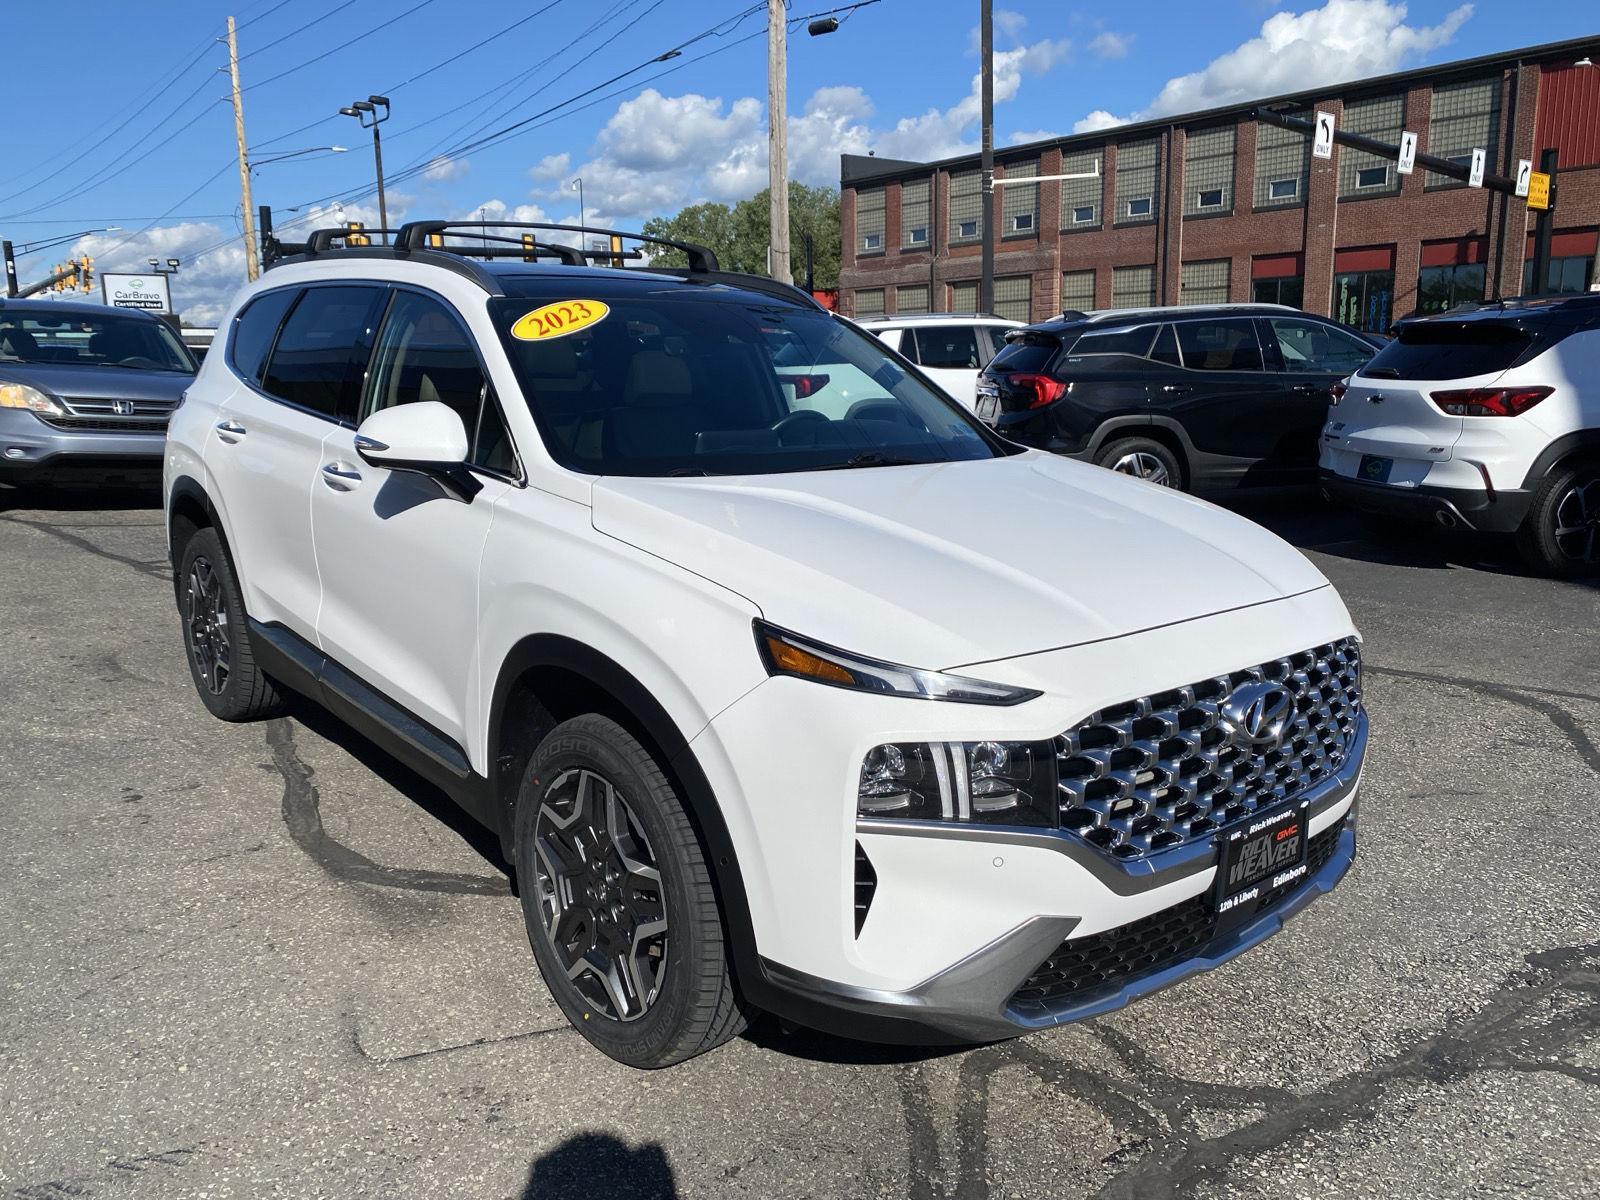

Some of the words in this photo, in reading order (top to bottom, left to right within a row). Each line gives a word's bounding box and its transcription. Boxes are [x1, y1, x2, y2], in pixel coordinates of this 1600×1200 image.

[1315, 143, 1330, 155] ONLY
[1400, 159, 1412, 169] ONLY
[115, 290, 160, 300] CarBravo
[529, 302, 592, 336] 2023
[1276, 824, 1298, 841] GMC
[1239, 831, 1275, 863] RICK
[1230, 836, 1300, 886] WEAVER
[1272, 864, 1307, 888] Edinboro
[1219, 898, 1233, 913] 12th
[1233, 895, 1239, 906] &
[1238, 887, 1260, 904] Liberty
